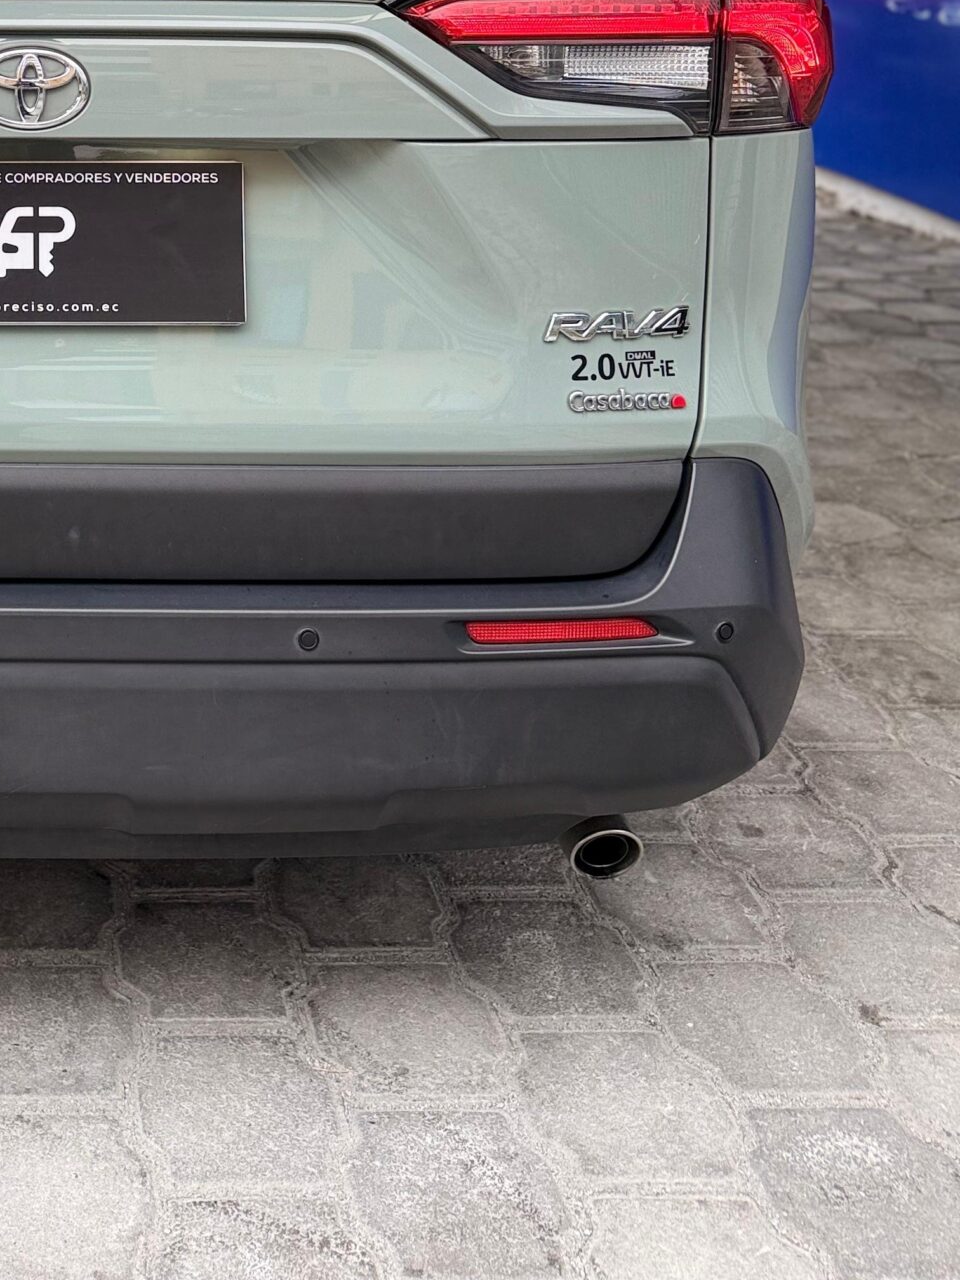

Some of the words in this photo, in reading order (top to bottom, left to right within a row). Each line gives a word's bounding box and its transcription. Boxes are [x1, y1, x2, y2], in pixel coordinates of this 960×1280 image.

[4, 172, 112, 184] COMPRADORES
[113, 172, 124, 183] Y
[125, 172, 219, 184] VENDEDORES
[543, 305, 691, 342] RAV4
[570, 353, 615, 381] 2.0
[626, 351, 655, 361] DUAL
[568, 389, 671, 412] Casabaca
